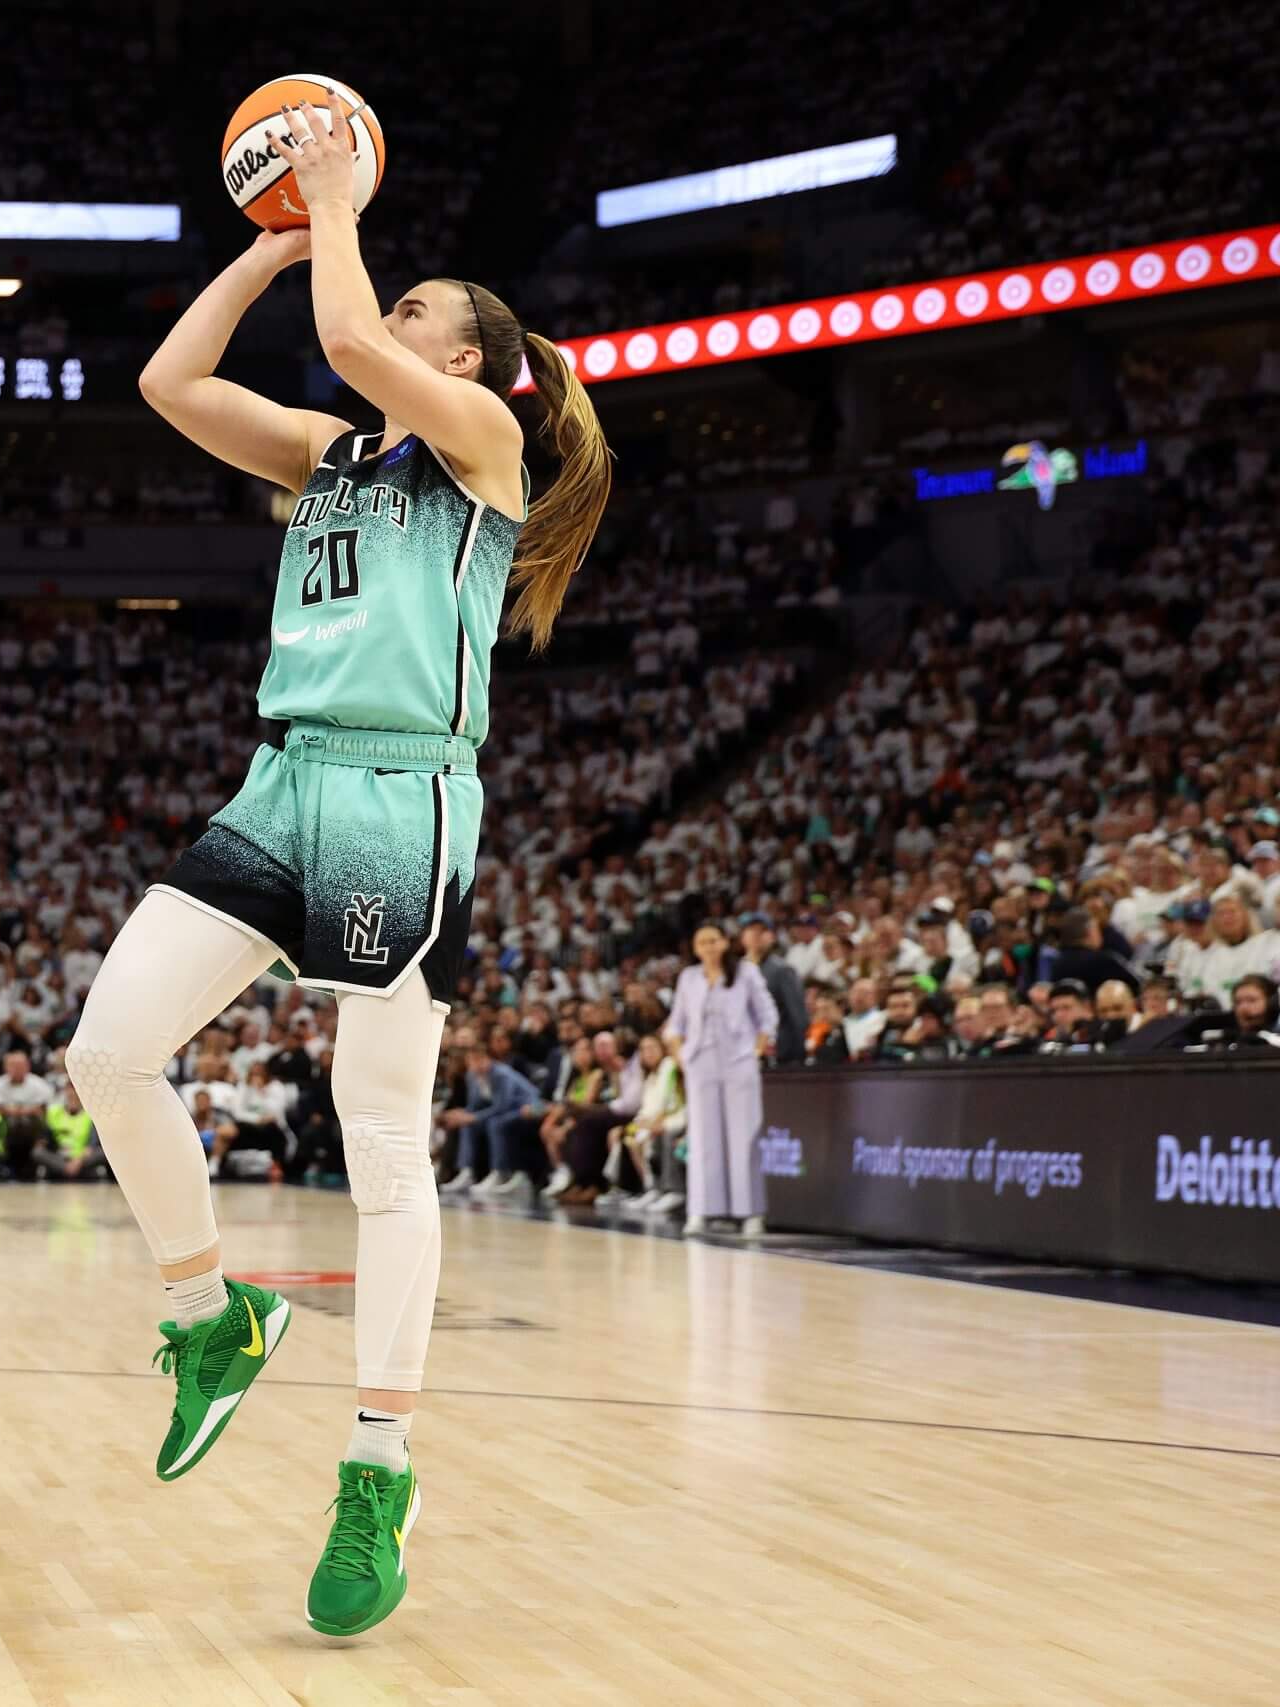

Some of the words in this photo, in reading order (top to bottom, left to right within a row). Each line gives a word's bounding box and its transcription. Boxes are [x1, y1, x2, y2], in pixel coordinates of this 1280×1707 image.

[300, 528, 361, 609] 20
[852, 1136, 902, 1176] Proud
[902, 1147, 971, 1188] sponsor
[972, 1138, 996, 1182] of
[994, 1150, 1082, 1197] progress
